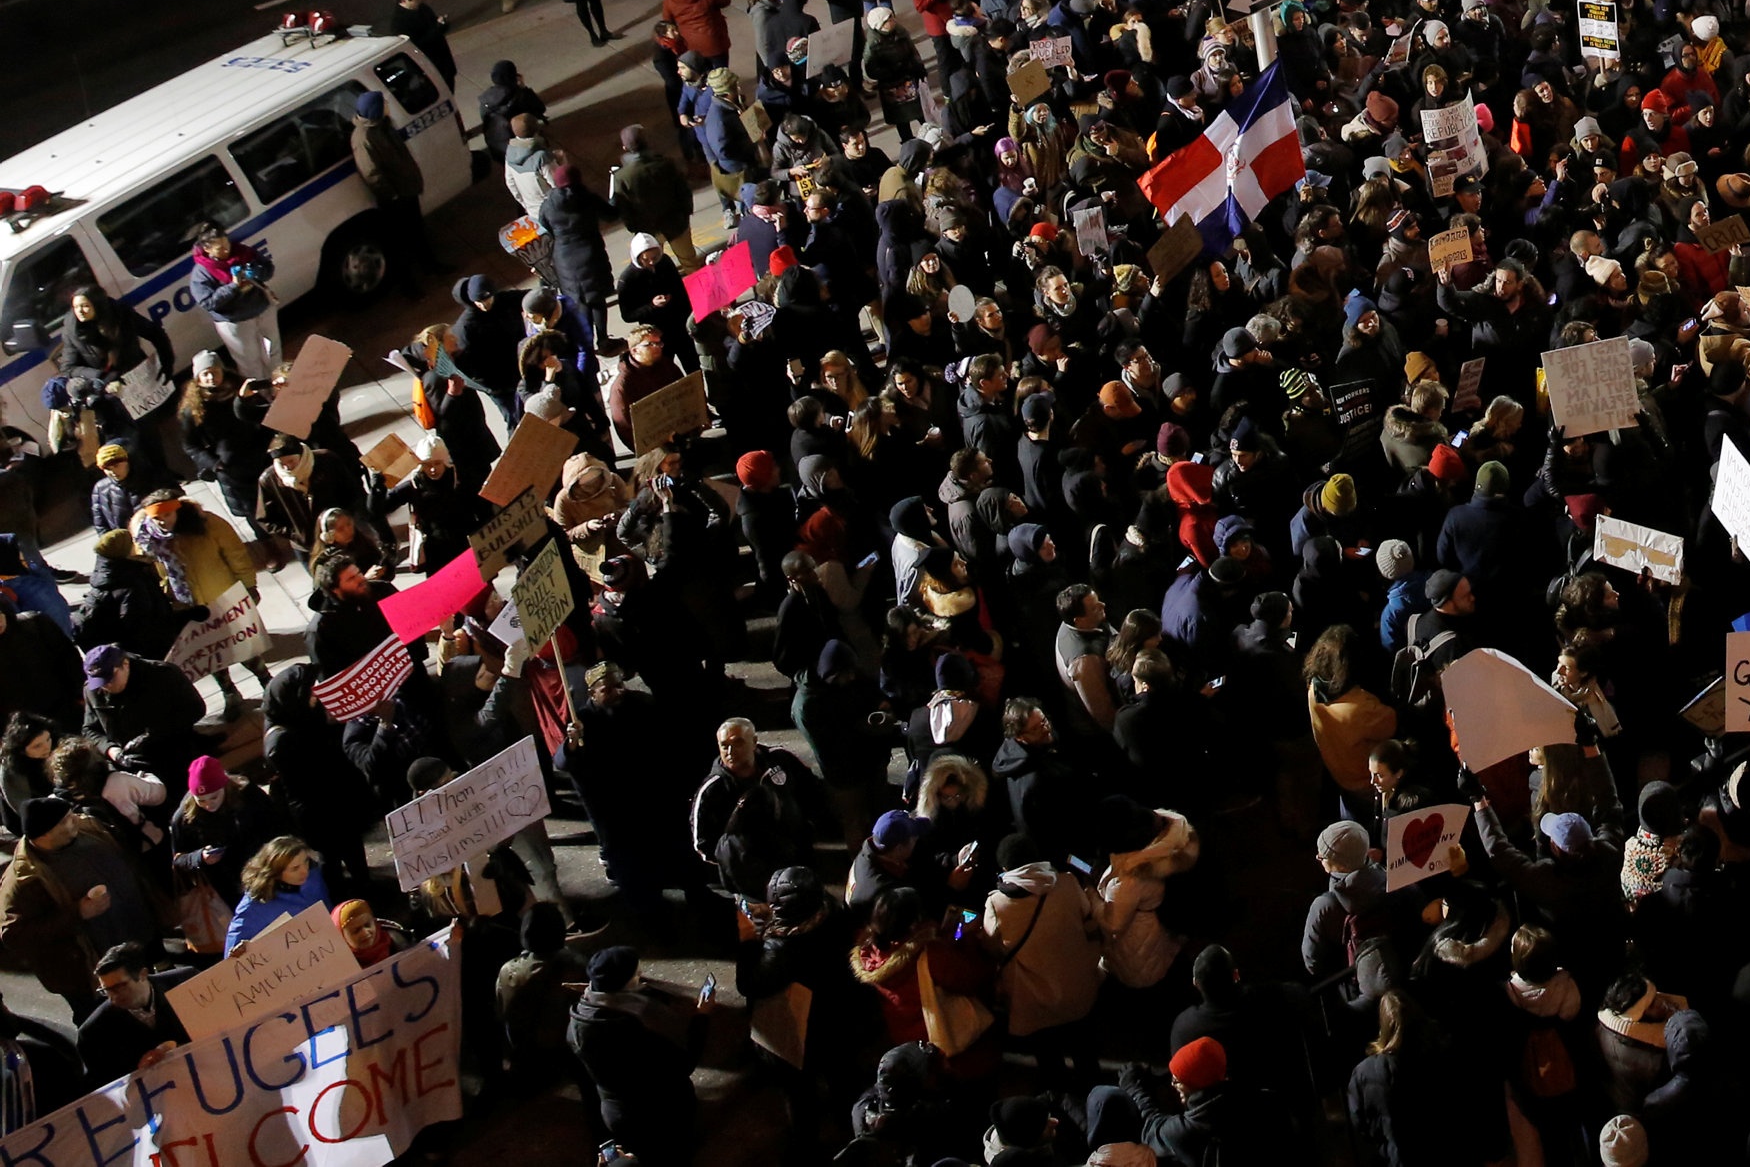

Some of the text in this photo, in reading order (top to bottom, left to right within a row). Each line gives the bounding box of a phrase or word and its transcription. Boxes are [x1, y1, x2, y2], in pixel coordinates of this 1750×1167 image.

[406, 105, 450, 139] 53225
[524, 573, 556, 617] BUILT
[533, 592, 558, 620] THIS
[528, 594, 571, 653] NATION
[340, 657, 397, 706] TO PROTECT
[350, 654, 386, 690] PLEDGE
[389, 798, 426, 838] LET
[187, 920, 323, 1009] WE ARE ALL
[231, 940, 337, 1016] AMERICAN
[0, 960, 440, 1167] REFUGEES
